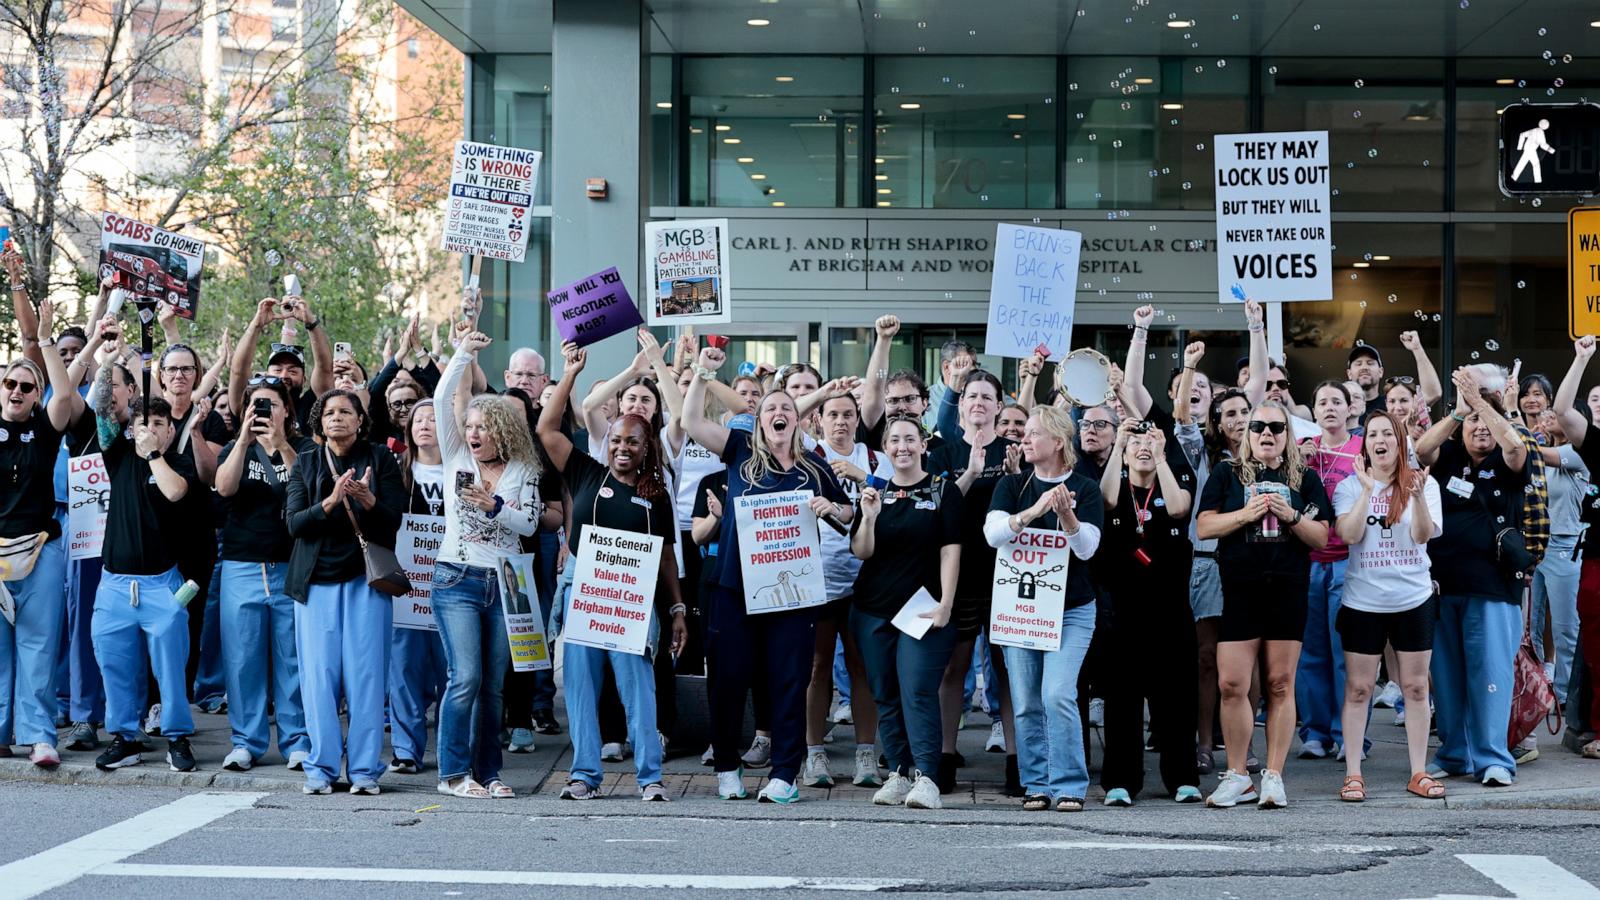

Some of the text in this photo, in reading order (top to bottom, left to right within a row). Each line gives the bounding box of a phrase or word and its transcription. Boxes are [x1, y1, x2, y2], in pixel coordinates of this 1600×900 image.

[461, 144, 534, 164] SOMETHING
[1234, 141, 1319, 160] THEY MAY
[465, 158, 531, 178] IS WRONG
[1219, 166, 1328, 186] LOCK US OUT
[466, 173, 521, 191] IN THERE
[455, 185, 529, 205] IF WE'RE OUT HERE
[464, 202, 507, 215] SAFE STAFFING
[1223, 199, 1321, 215] BUT THEY WILL
[461, 223, 505, 234] RESPECT NURSES
[478, 216, 498, 225] WAGES
[105, 215, 202, 255] SCABS GO HOME!
[447, 236, 471, 244] INVEST
[460, 229, 505, 240] PROTECT PATIENTS
[665, 229, 704, 247] MGB
[1014, 229, 1072, 254] BRING
[1226, 228, 1325, 242] NEVER TAKE OUR
[446, 243, 473, 254] INVEST
[732, 237, 780, 250] CARL
[785, 238, 797, 252] J.
[804, 238, 844, 250] AND
[851, 238, 900, 250] RUTH
[907, 238, 988, 251] SHAPIRO
[659, 249, 715, 264] GAMBLING
[660, 266, 717, 278] PATIENTS LIVES
[789, 259, 812, 272] AT
[819, 259, 904, 272] BRIGHAM
[911, 260, 951, 272] AND
[1016, 254, 1064, 281] BACK
[1234, 254, 1317, 279] VOICES
[550, 272, 620, 307] NOW WILL YOU
[1018, 285, 1051, 306] THE
[562, 293, 618, 320] NEGOTIATE
[575, 315, 607, 334] MGB?
[997, 305, 1071, 330] BRIGHAM
[248, 471, 261, 480] AS
[780, 494, 808, 502] Nurses
[753, 505, 799, 520] FIGHTING
[406, 520, 428, 533] Mass
[756, 526, 800, 542] PATIENTS
[589, 532, 653, 553] Mass General
[764, 542, 780, 550] and
[596, 551, 640, 568] Brigham:
[751, 546, 810, 565] PROFESSION
[1012, 550, 1047, 564] OUT
[594, 568, 636, 584] Value the
[581, 583, 644, 603] Essential Care
[573, 599, 645, 621] Brigham Nurses
[1016, 604, 1035, 613] MGB
[590, 619, 625, 635] Provide
[997, 614, 1055, 628] disrespecting
[993, 624, 1058, 639] Brigham nurses
